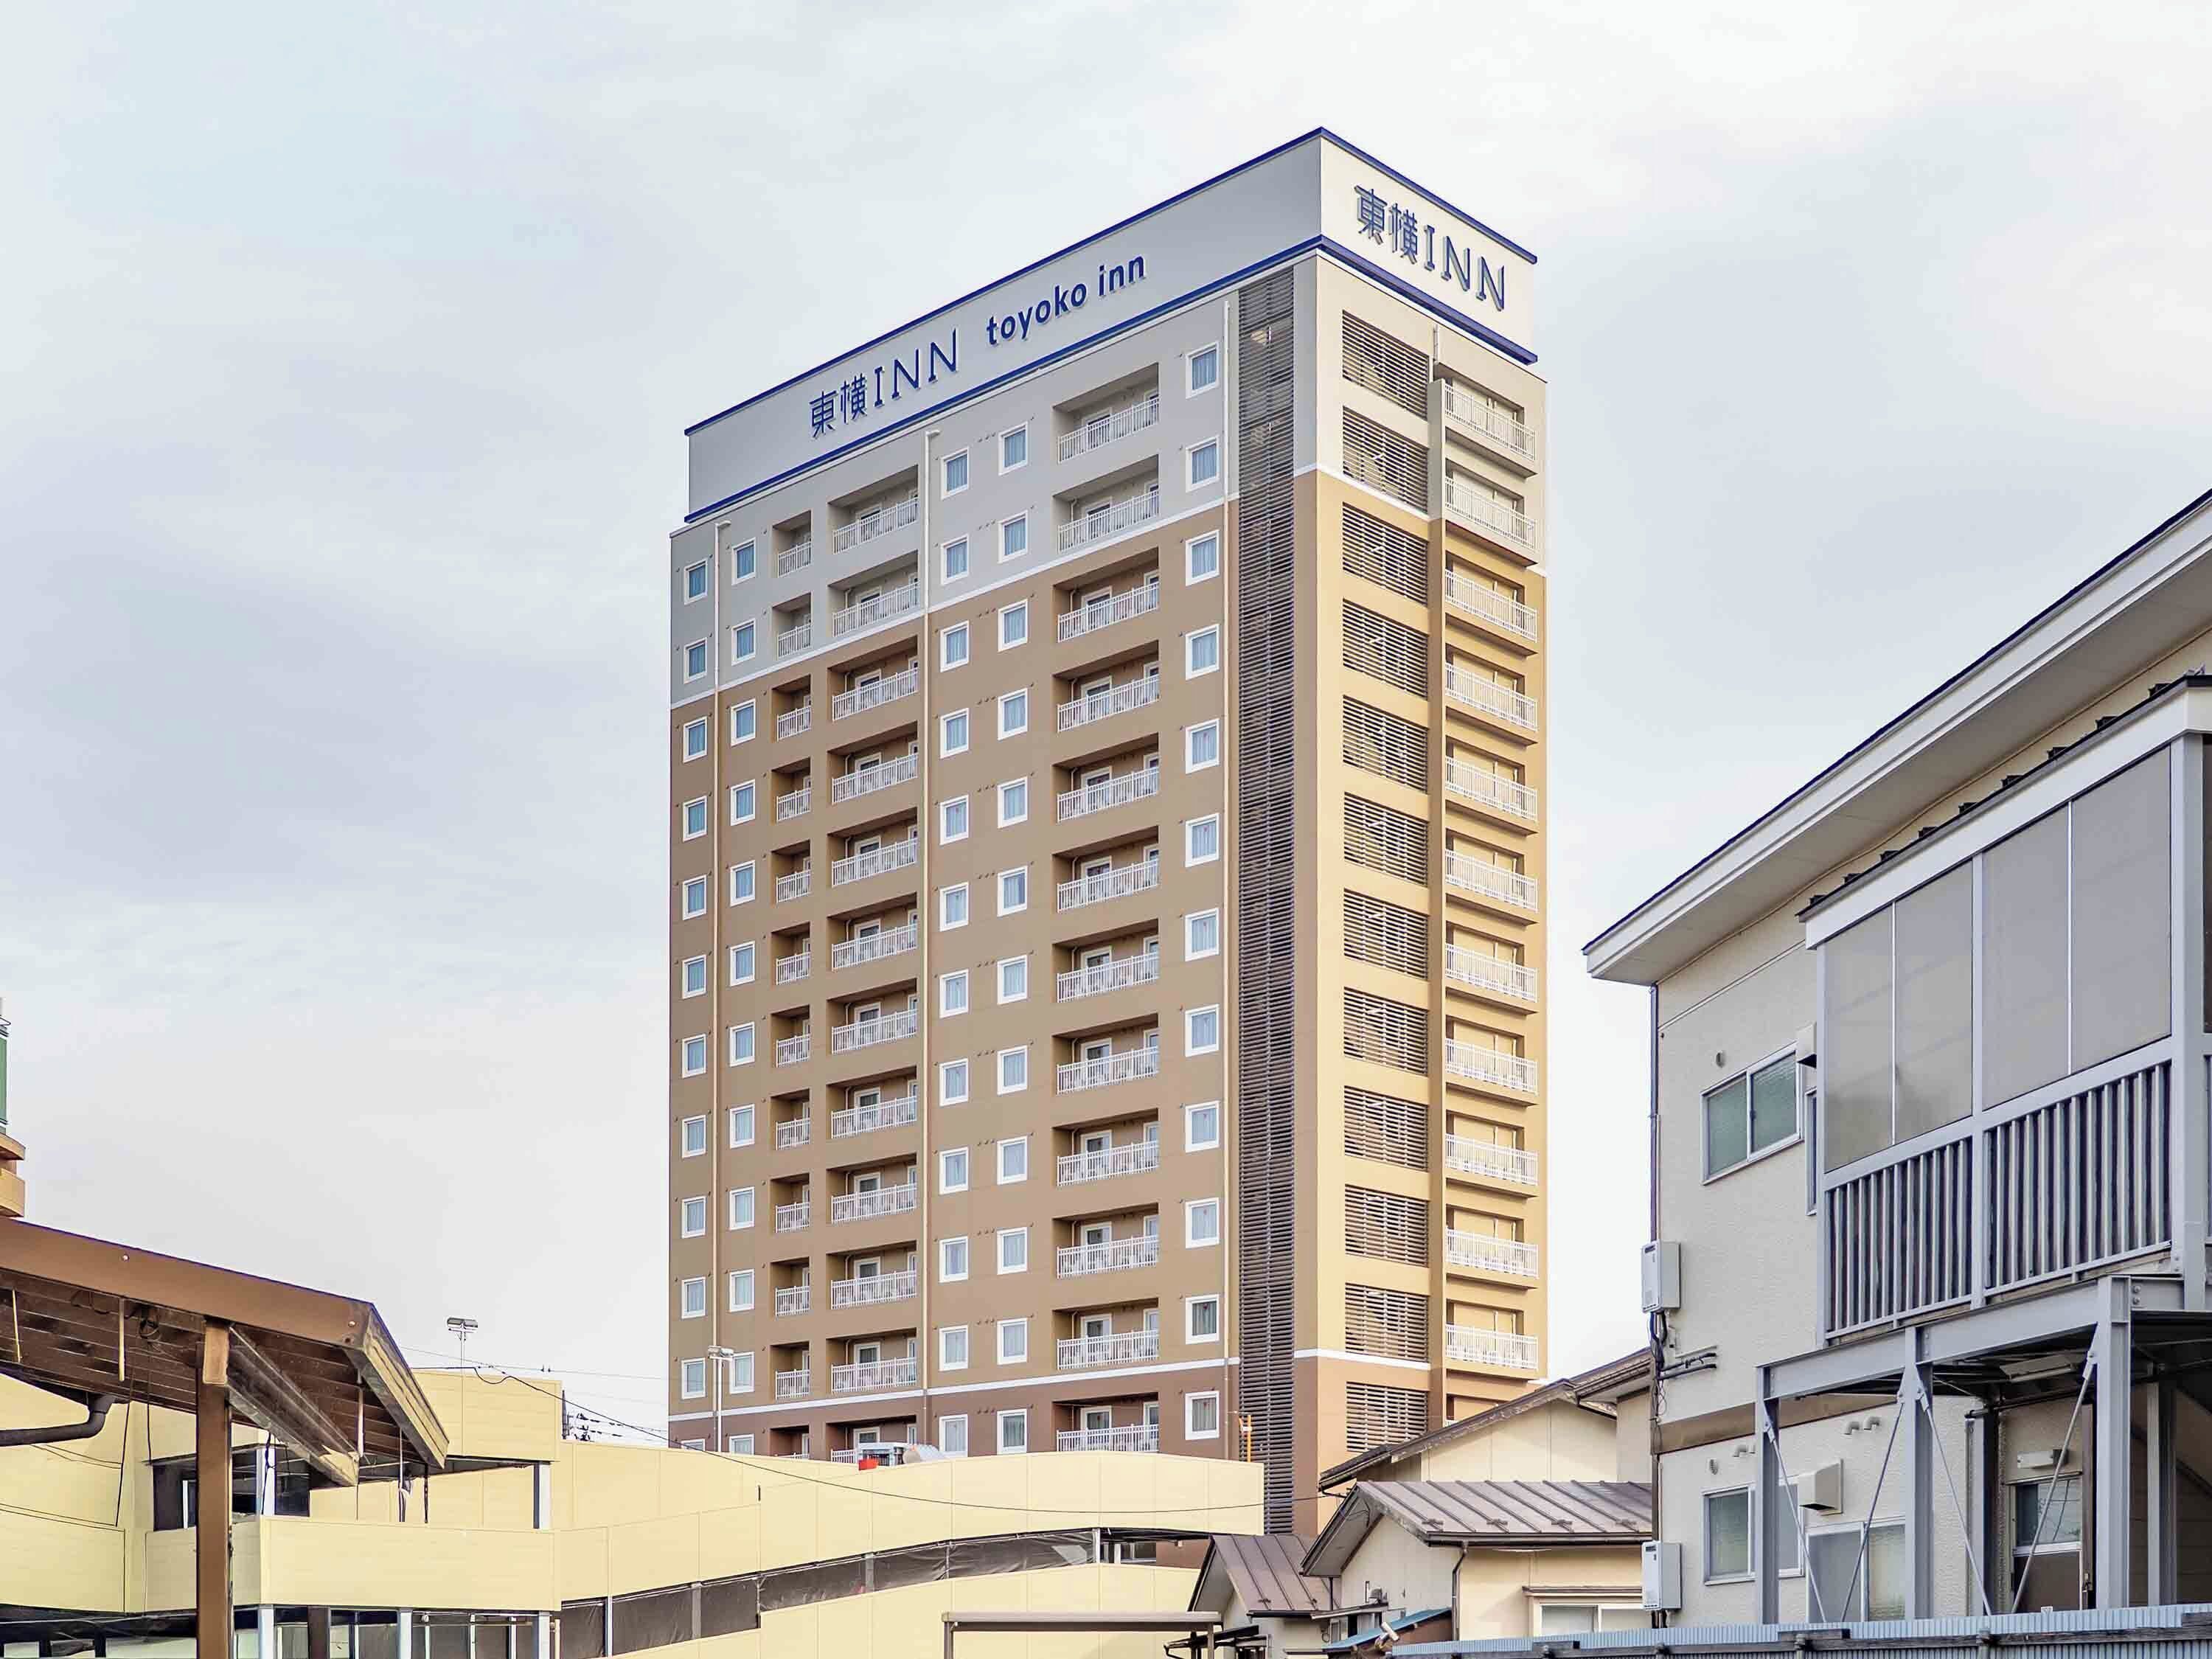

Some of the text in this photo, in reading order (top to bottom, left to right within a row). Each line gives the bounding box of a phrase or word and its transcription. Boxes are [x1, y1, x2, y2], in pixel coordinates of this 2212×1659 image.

[1354, 184, 1505, 312] 東横INN
[809, 255, 1145, 439] 東横INN toyoko inn
